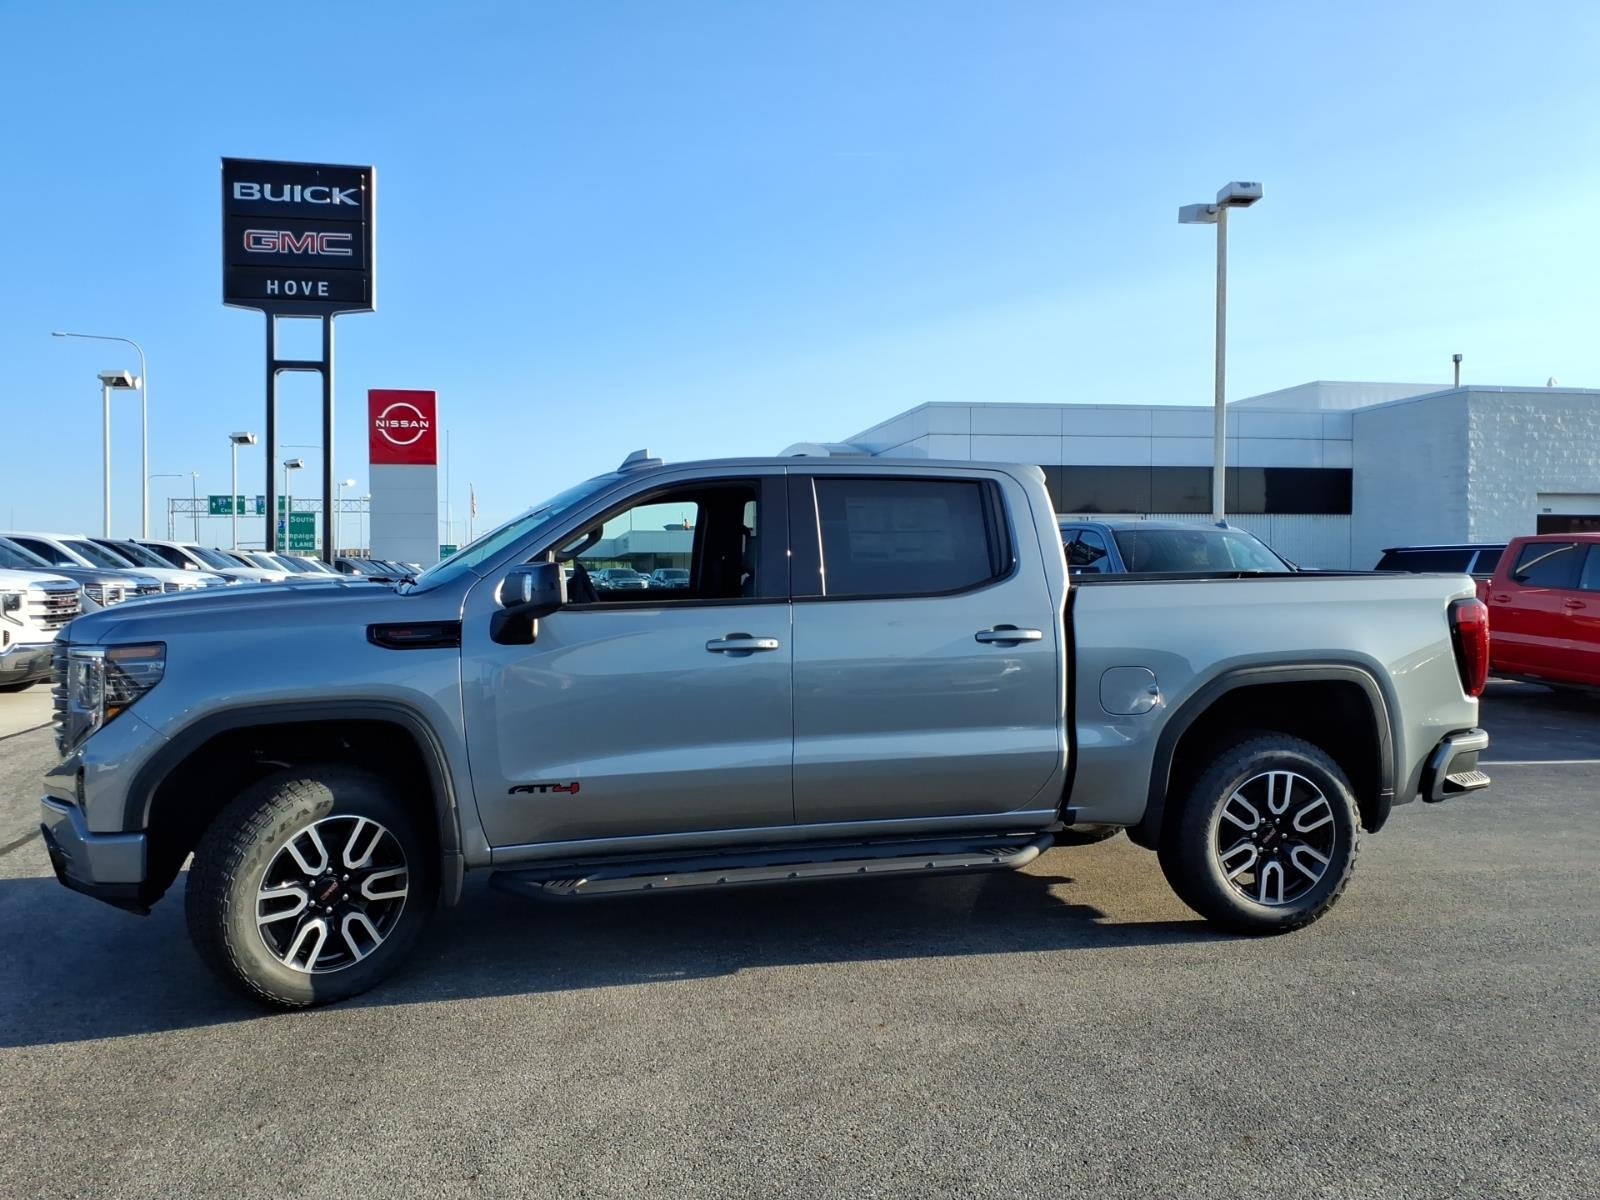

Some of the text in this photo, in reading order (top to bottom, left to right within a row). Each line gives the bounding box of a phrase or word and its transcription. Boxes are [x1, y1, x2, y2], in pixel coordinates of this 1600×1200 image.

[233, 182, 360, 206] BUICK
[243, 229, 353, 256] GMC
[266, 279, 329, 297] HOVE
[375, 420, 429, 428] NISSAN
[508, 782, 580, 795] AT4
